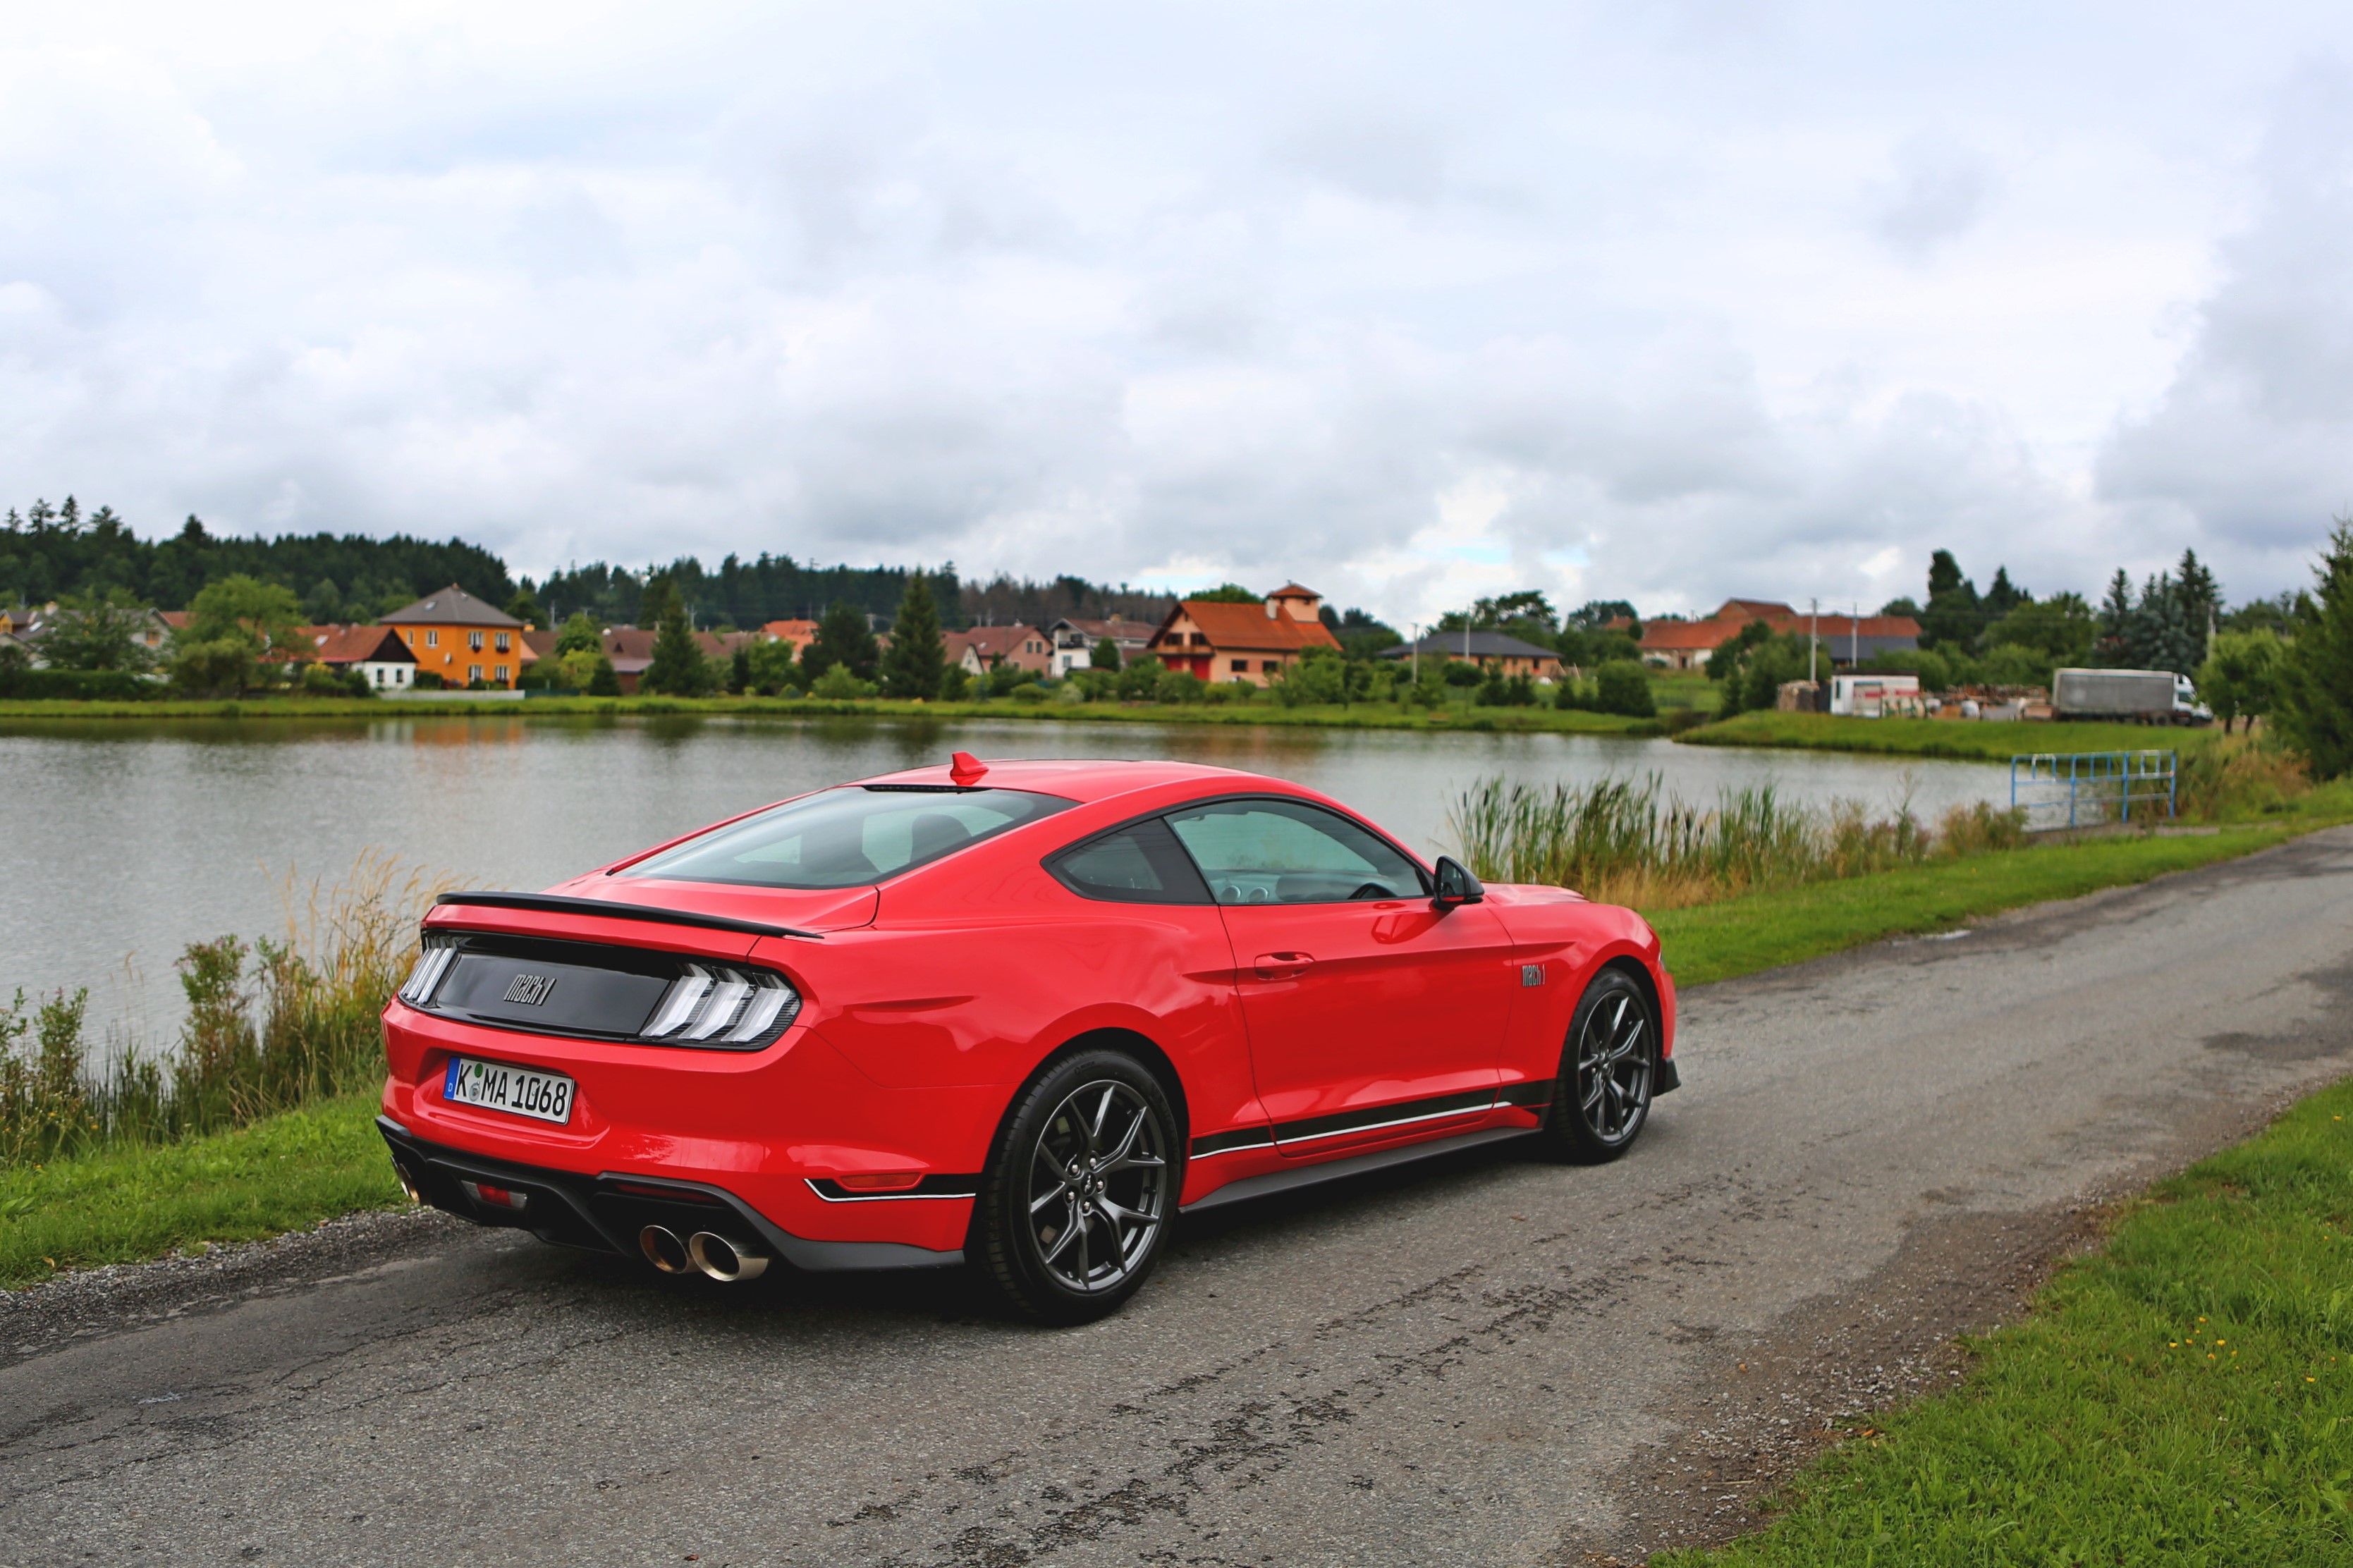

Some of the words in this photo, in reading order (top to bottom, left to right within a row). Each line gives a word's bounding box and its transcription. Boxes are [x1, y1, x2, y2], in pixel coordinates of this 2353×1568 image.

[538, 978, 556, 1006] 1
[448, 1082, 453, 1092] D
[456, 1063, 472, 1097] K
[481, 1068, 508, 1105] MA
[511, 1074, 568, 1117] 1068
